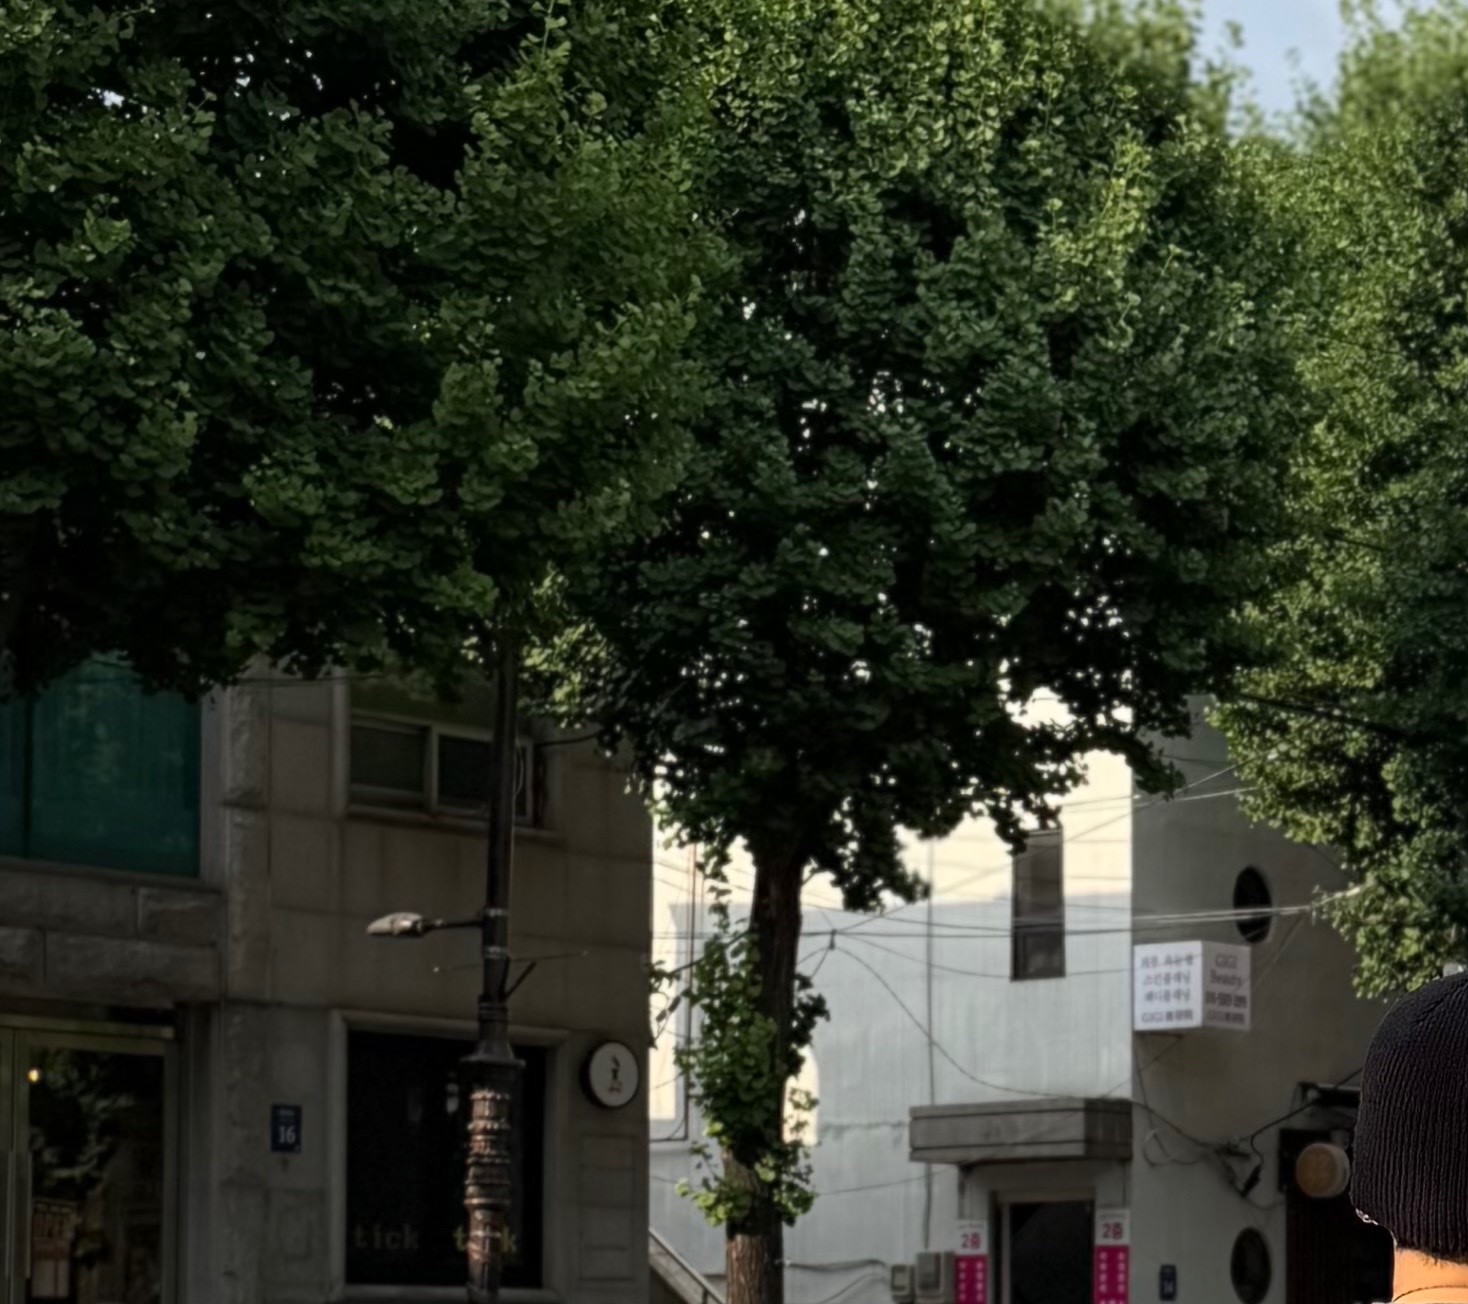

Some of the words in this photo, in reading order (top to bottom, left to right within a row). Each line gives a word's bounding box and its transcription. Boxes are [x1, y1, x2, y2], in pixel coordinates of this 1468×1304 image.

[279, 1125, 296, 1144] 16
[352, 1223, 418, 1249] tick
[453, 1224, 517, 1251] tk
